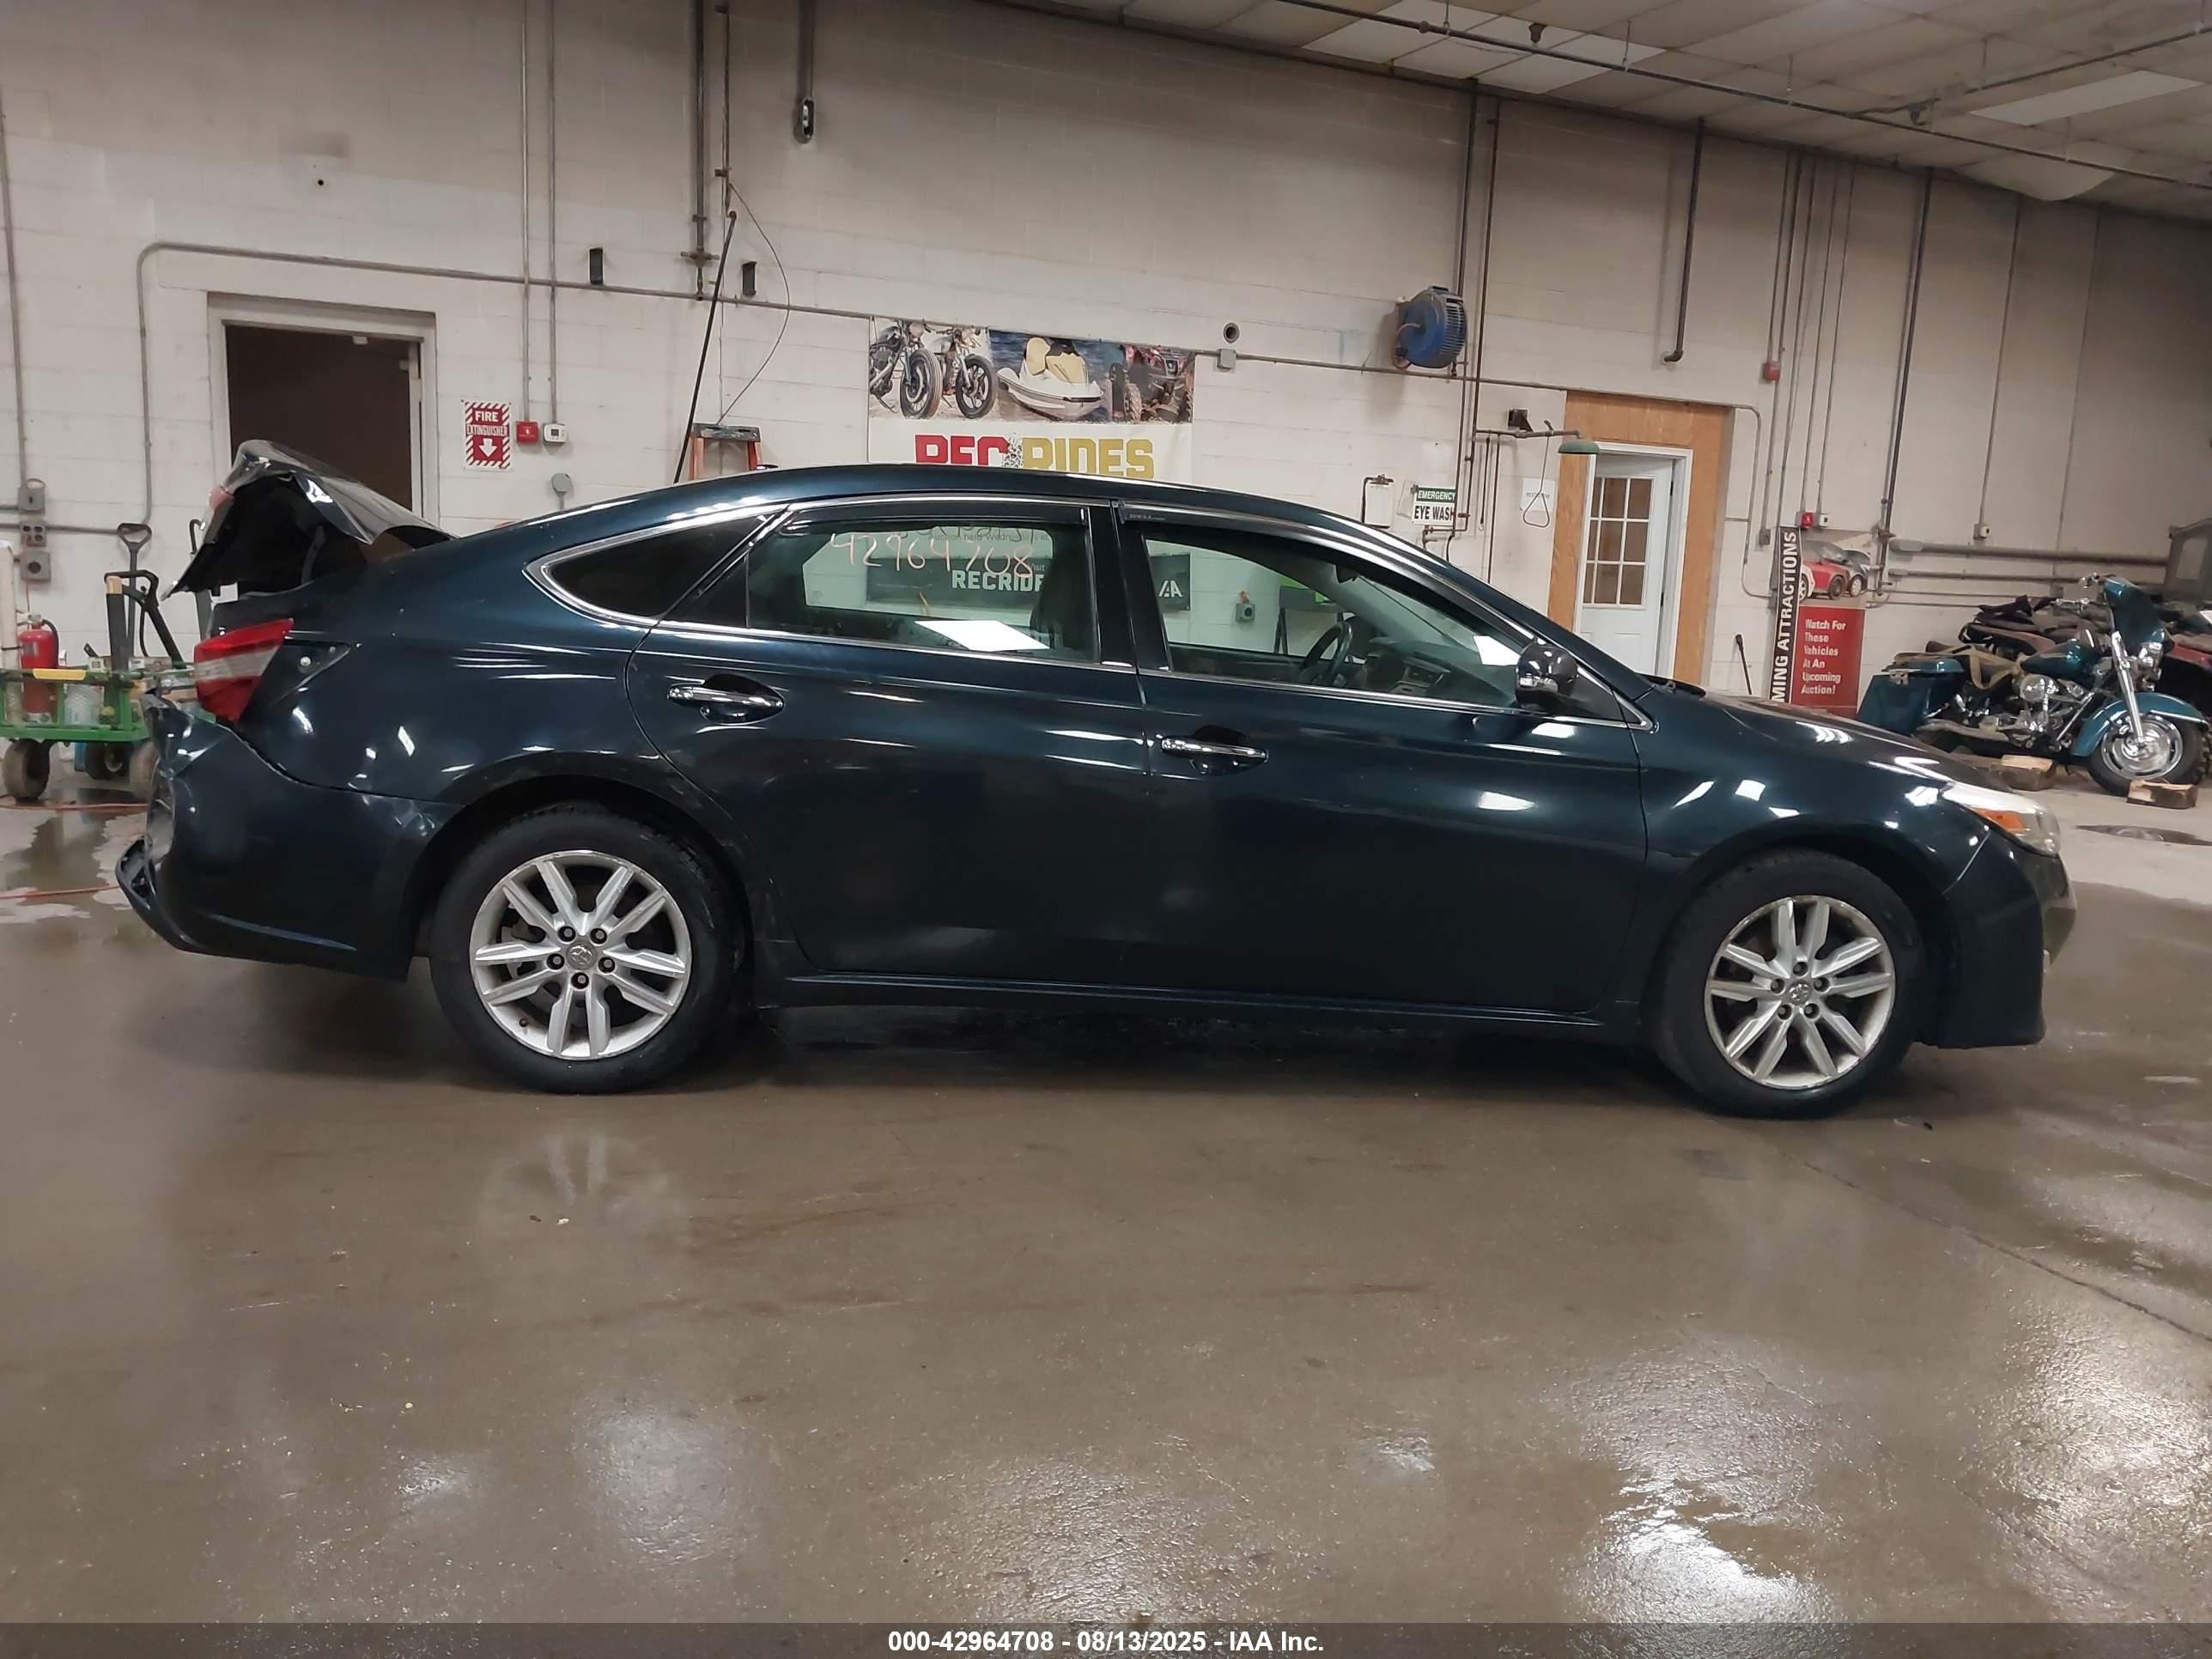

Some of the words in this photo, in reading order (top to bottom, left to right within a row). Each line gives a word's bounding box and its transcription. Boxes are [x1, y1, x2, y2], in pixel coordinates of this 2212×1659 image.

[475, 410, 499, 422] FIRE
[466, 424, 508, 436] EXTINGUISHER
[1023, 437, 1156, 480] RIDES
[1418, 490, 1455, 500] EMERGENCY
[1414, 505, 1430, 520] EYE
[1777, 531, 1798, 651] ATTRACTIONS
[1832, 620, 1846, 630] For
[1804, 632, 1829, 643] These
[1804, 645, 1838, 656] Vehicles
[1812, 658, 1826, 668] An
[1802, 672, 1841, 684] Upcoming
[1801, 684, 1836, 695] Auction!
